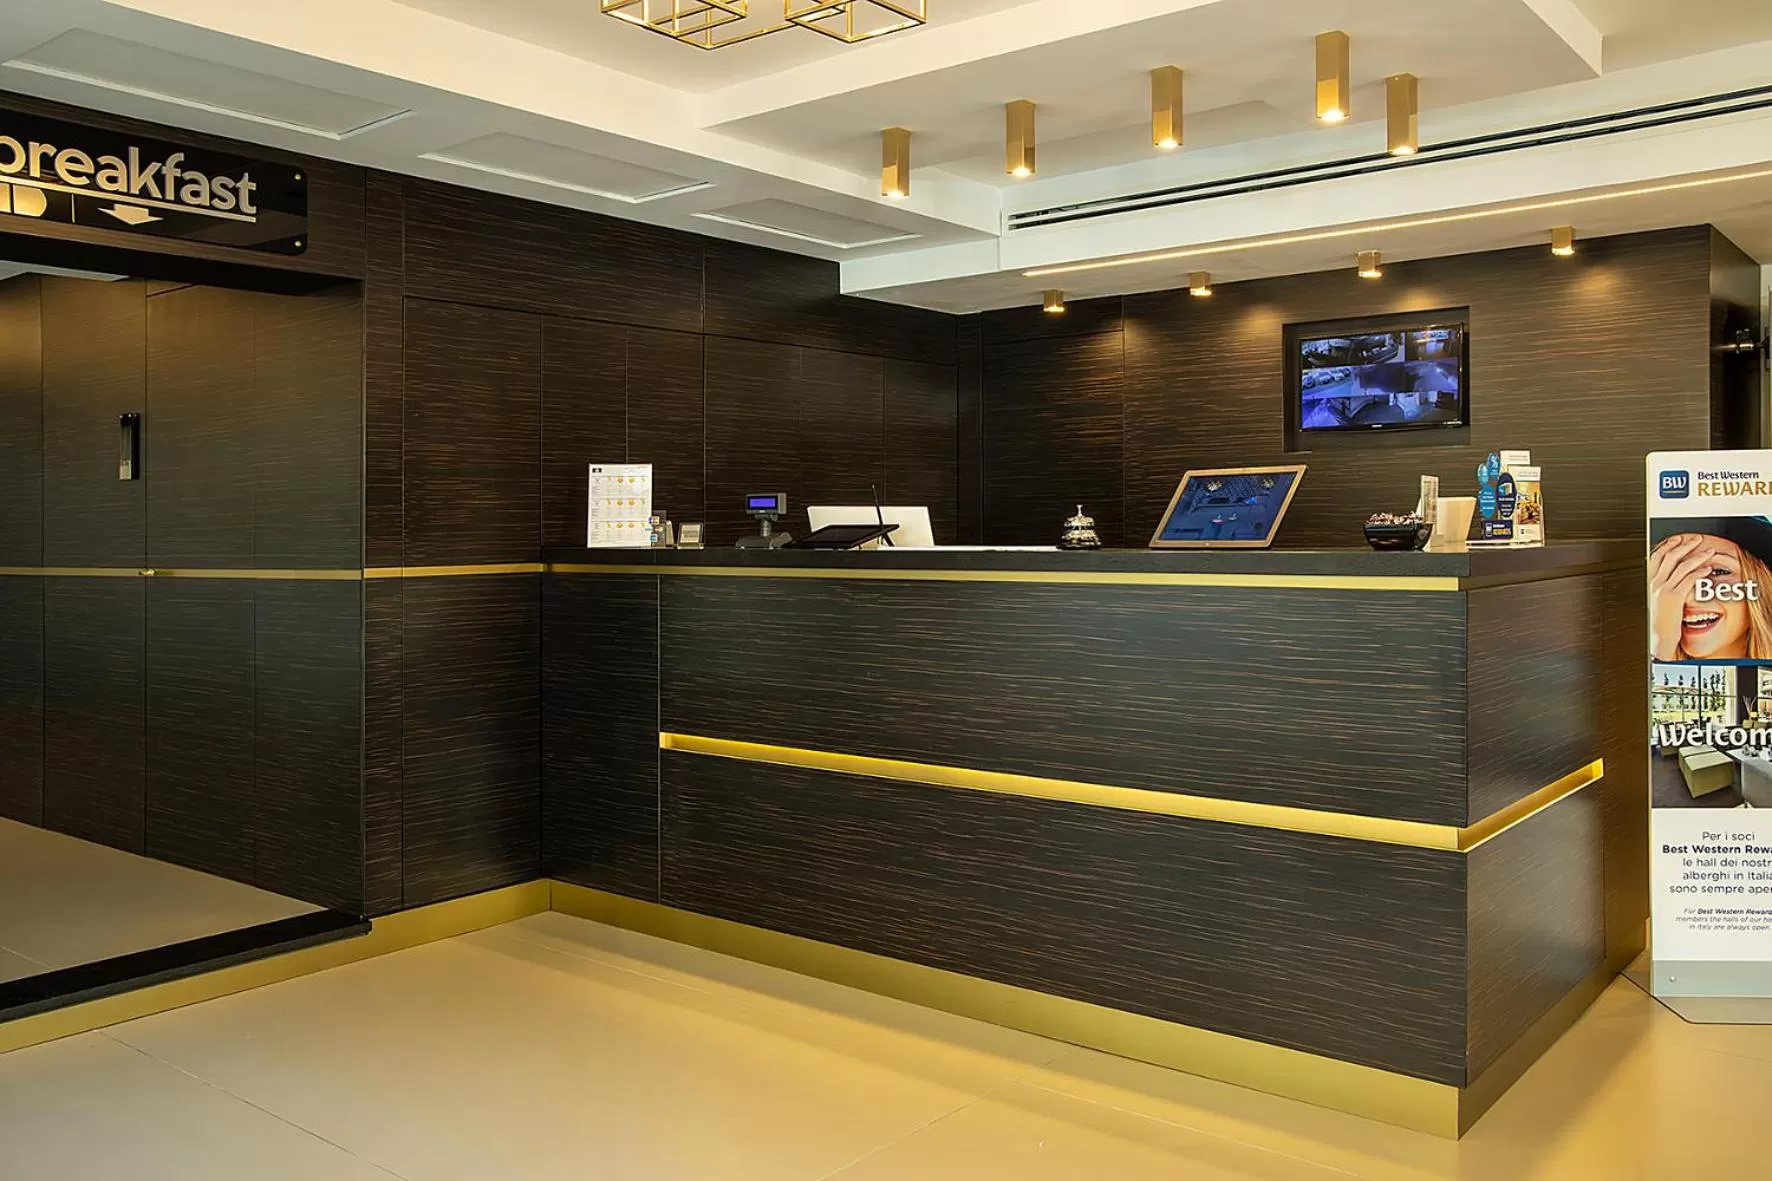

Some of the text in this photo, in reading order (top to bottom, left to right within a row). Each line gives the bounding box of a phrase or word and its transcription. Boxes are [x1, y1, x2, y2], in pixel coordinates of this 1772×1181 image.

[1697, 471, 1760, 480] Best Western
[1662, 476, 1687, 489] BW
[1694, 577, 1759, 602] Best
[1659, 721, 1772, 747] Welcom
[1702, 831, 1722, 841] Per
[1731, 831, 1755, 841] soci
[1662, 844, 1688, 854] Best
[1691, 844, 1741, 854] Western
[1682, 858, 1693, 867] le
[1696, 858, 1717, 867] hall
[1719, 858, 1738, 867] dei
[1682, 871, 1731, 882] alberghi
[1733, 871, 1744, 881] in
[1669, 885, 1698, 894] sono
[1701, 885, 1745, 895] sempre
